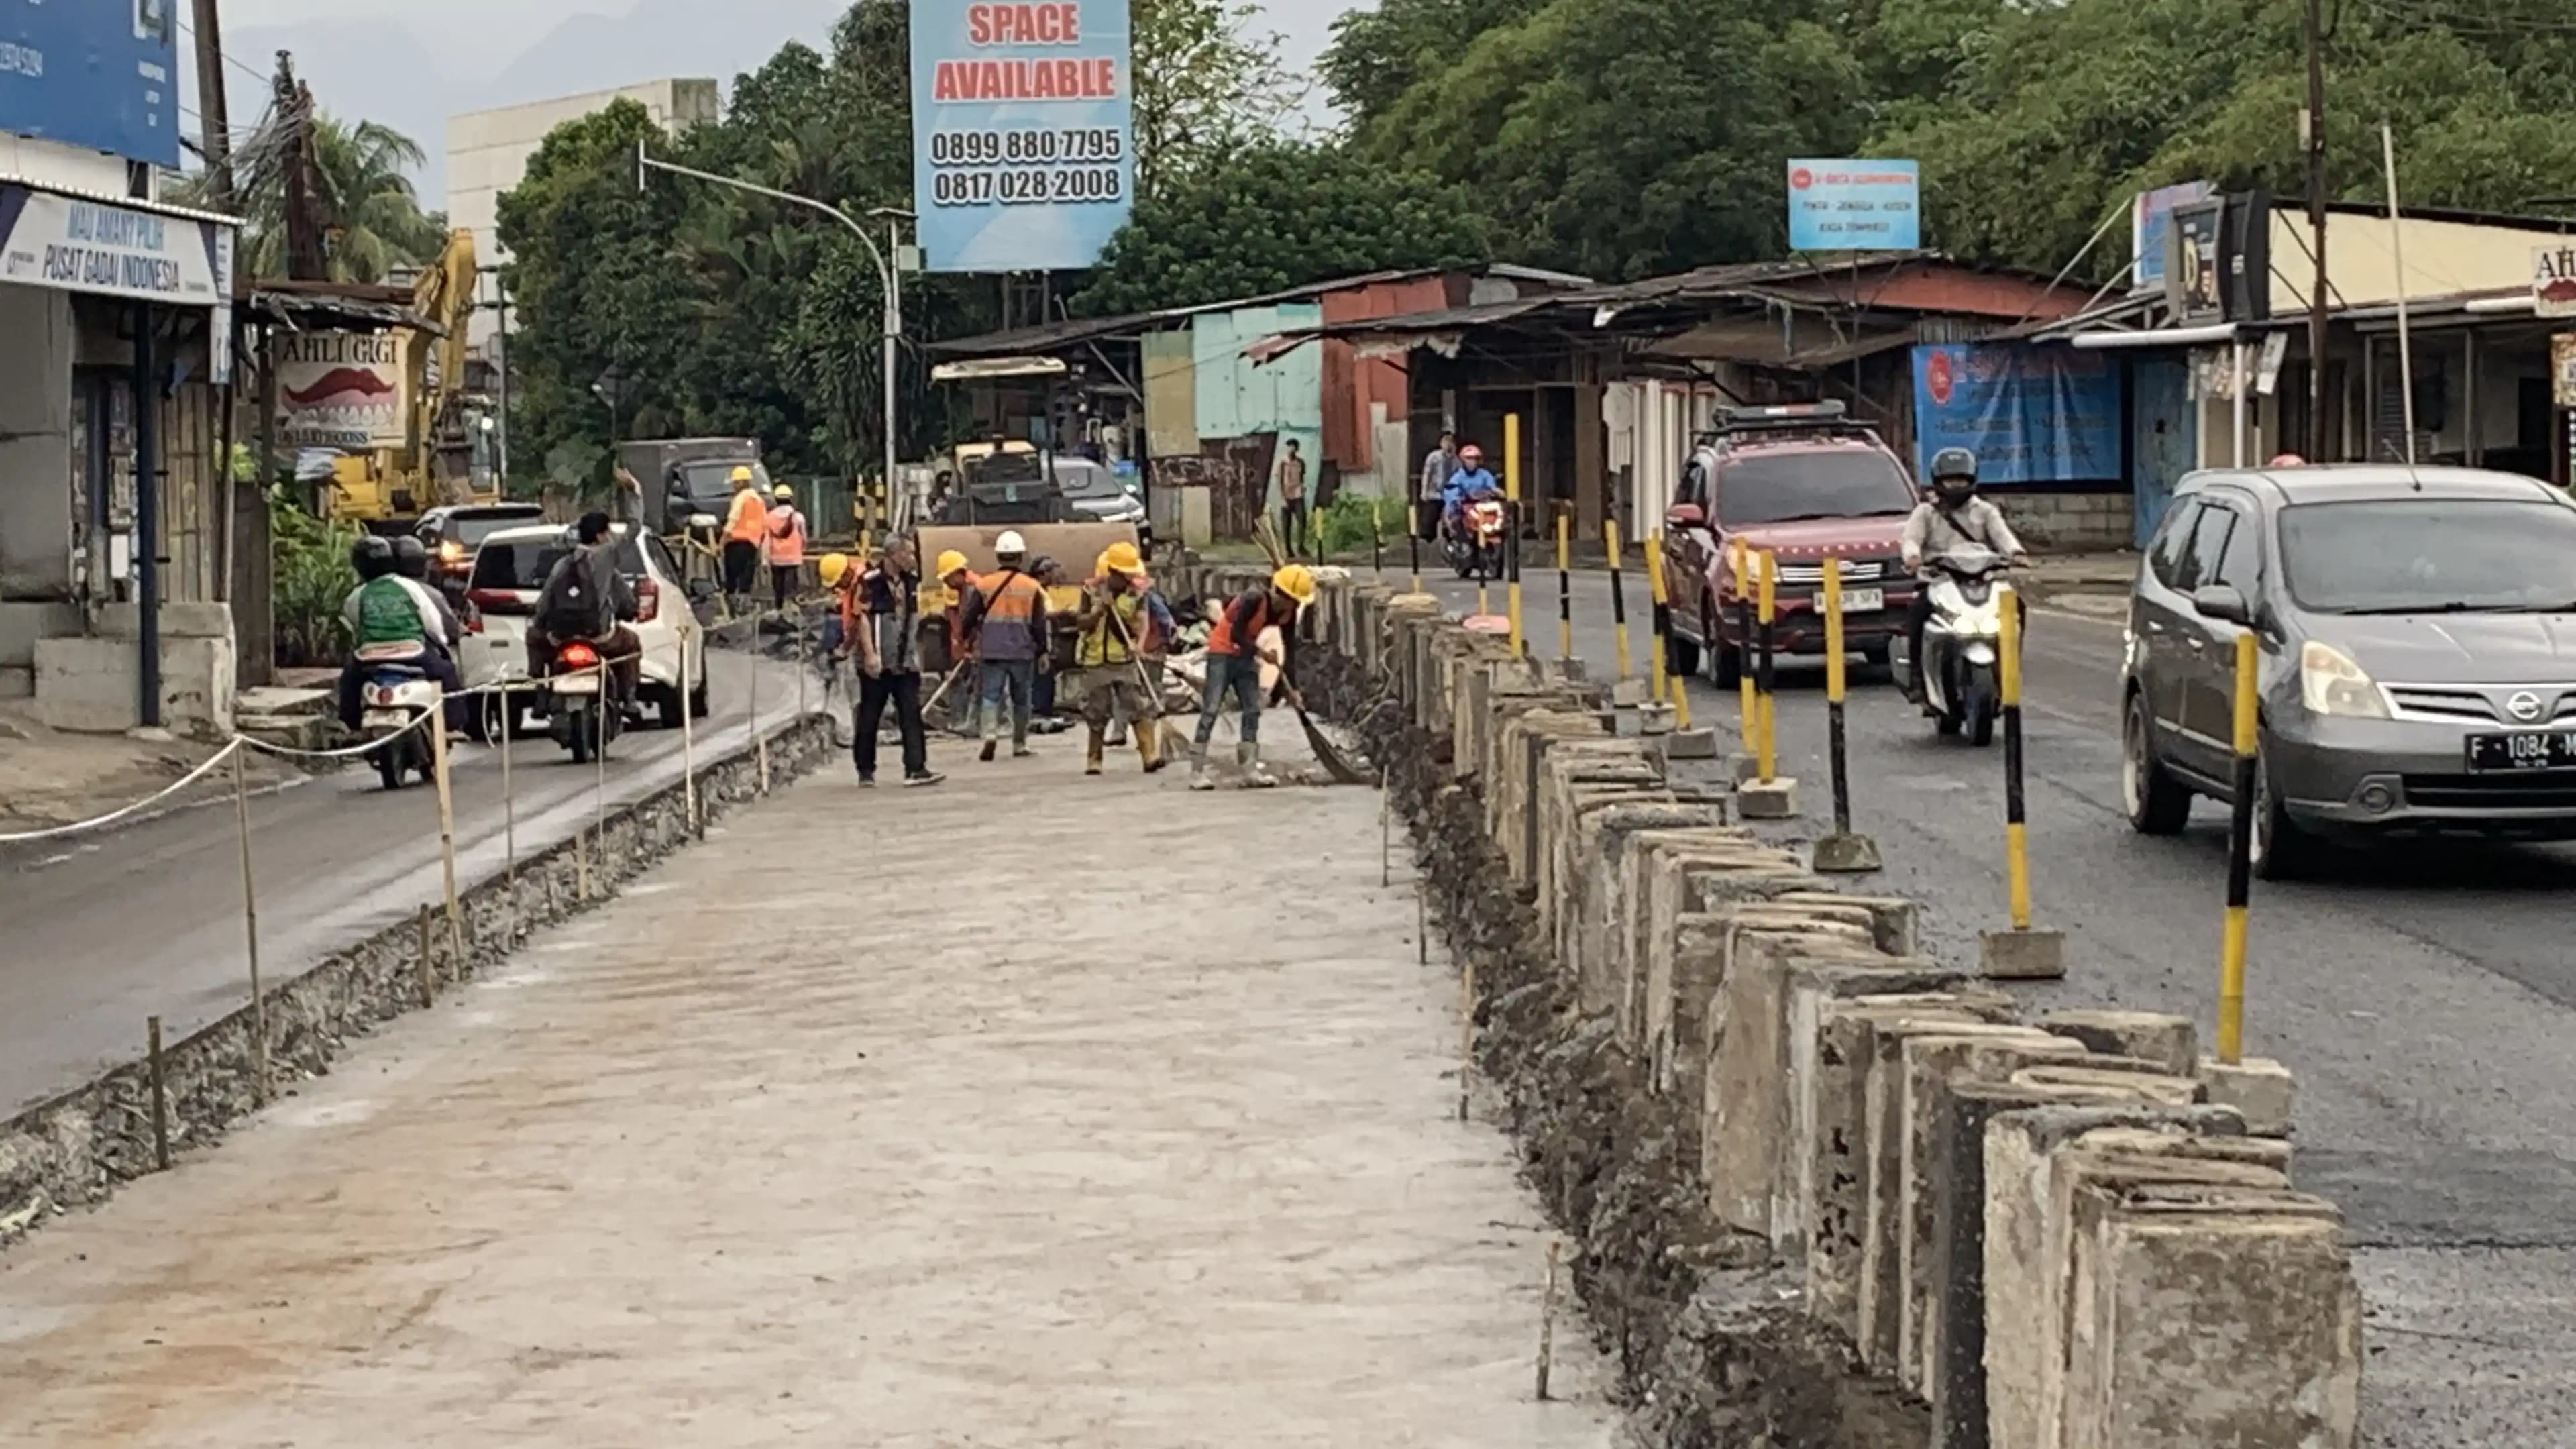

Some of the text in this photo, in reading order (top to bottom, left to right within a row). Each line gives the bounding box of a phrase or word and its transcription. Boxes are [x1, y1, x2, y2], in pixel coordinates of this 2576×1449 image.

[969, 3, 1079, 44] SPACE
[934, 59, 1115, 99] AVAILABLE
[42, 244, 84, 282] PUSAT
[84, 250, 118, 286] GADAI
[120, 254, 180, 293] INDONESIA
[283, 336, 397, 364] AHLI GIGI
[2471, 737, 2484, 759] F
